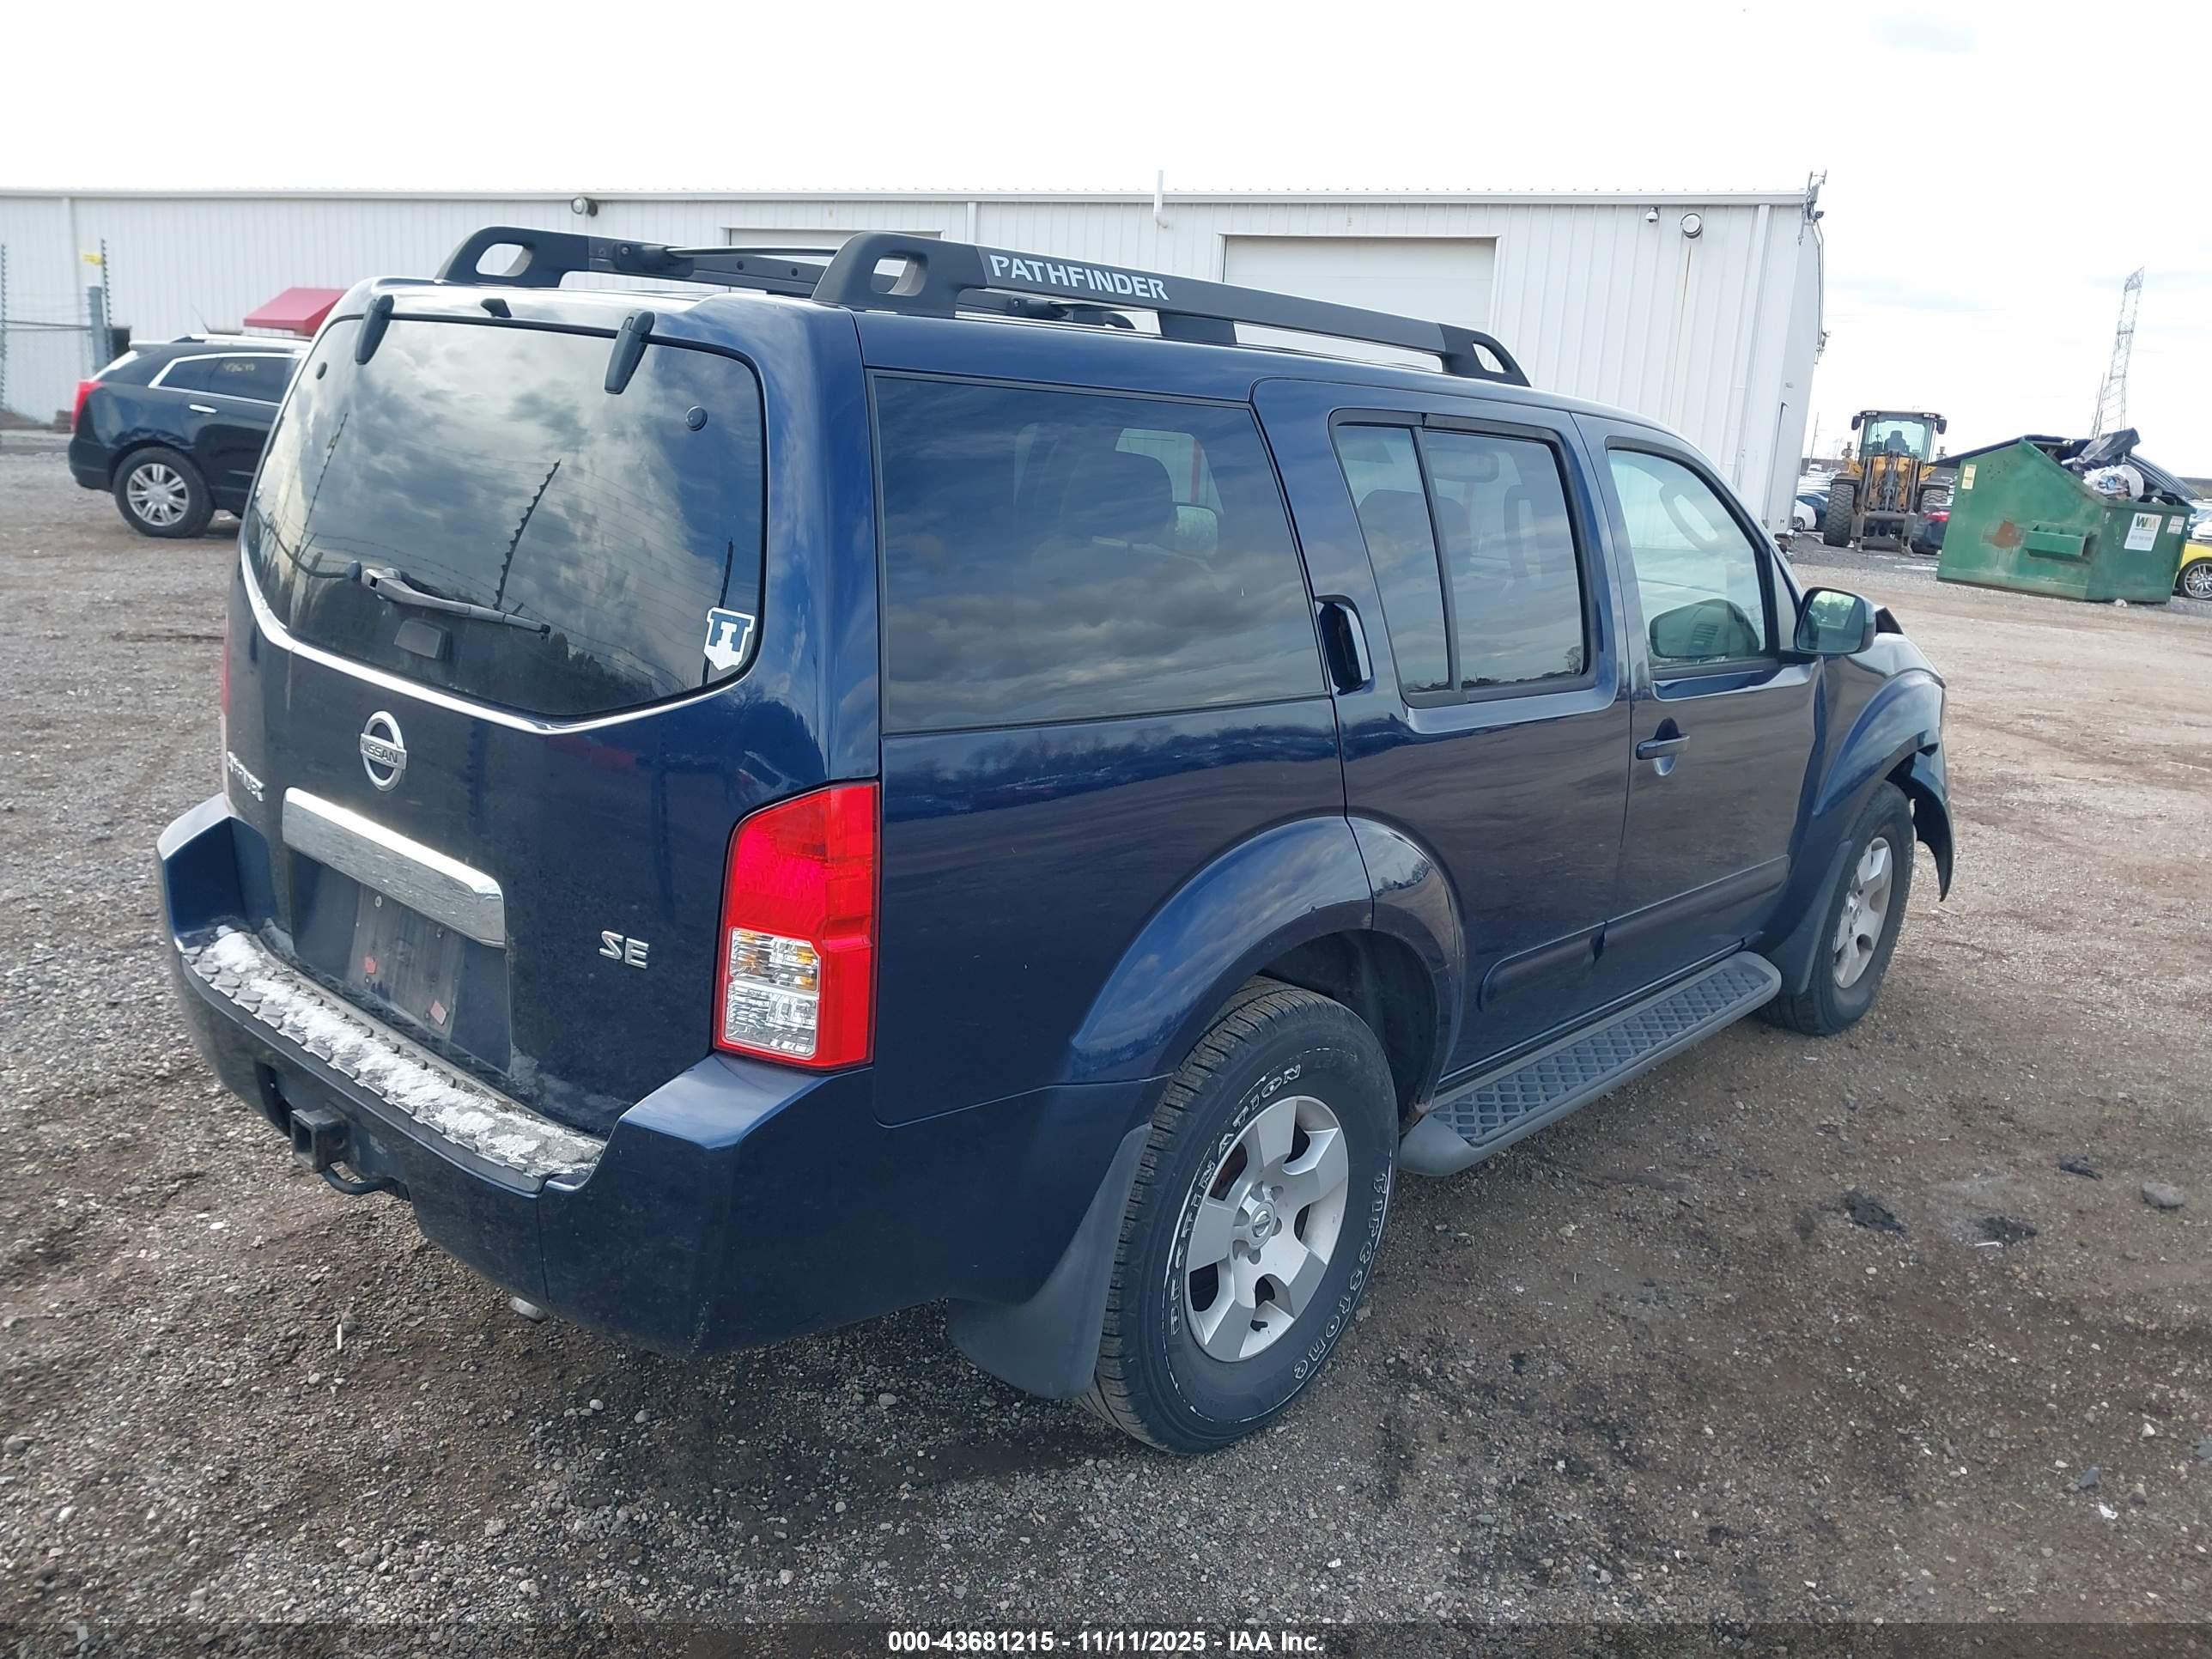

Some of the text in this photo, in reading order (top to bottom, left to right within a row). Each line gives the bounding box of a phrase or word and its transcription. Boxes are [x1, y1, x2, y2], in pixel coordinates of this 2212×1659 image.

[989, 255, 1170, 301] PATHFINDER
[362, 739, 398, 765] NISSAN
[599, 930, 649, 969] SE
[1170, 1063, 1302, 1336] DESTINATION
